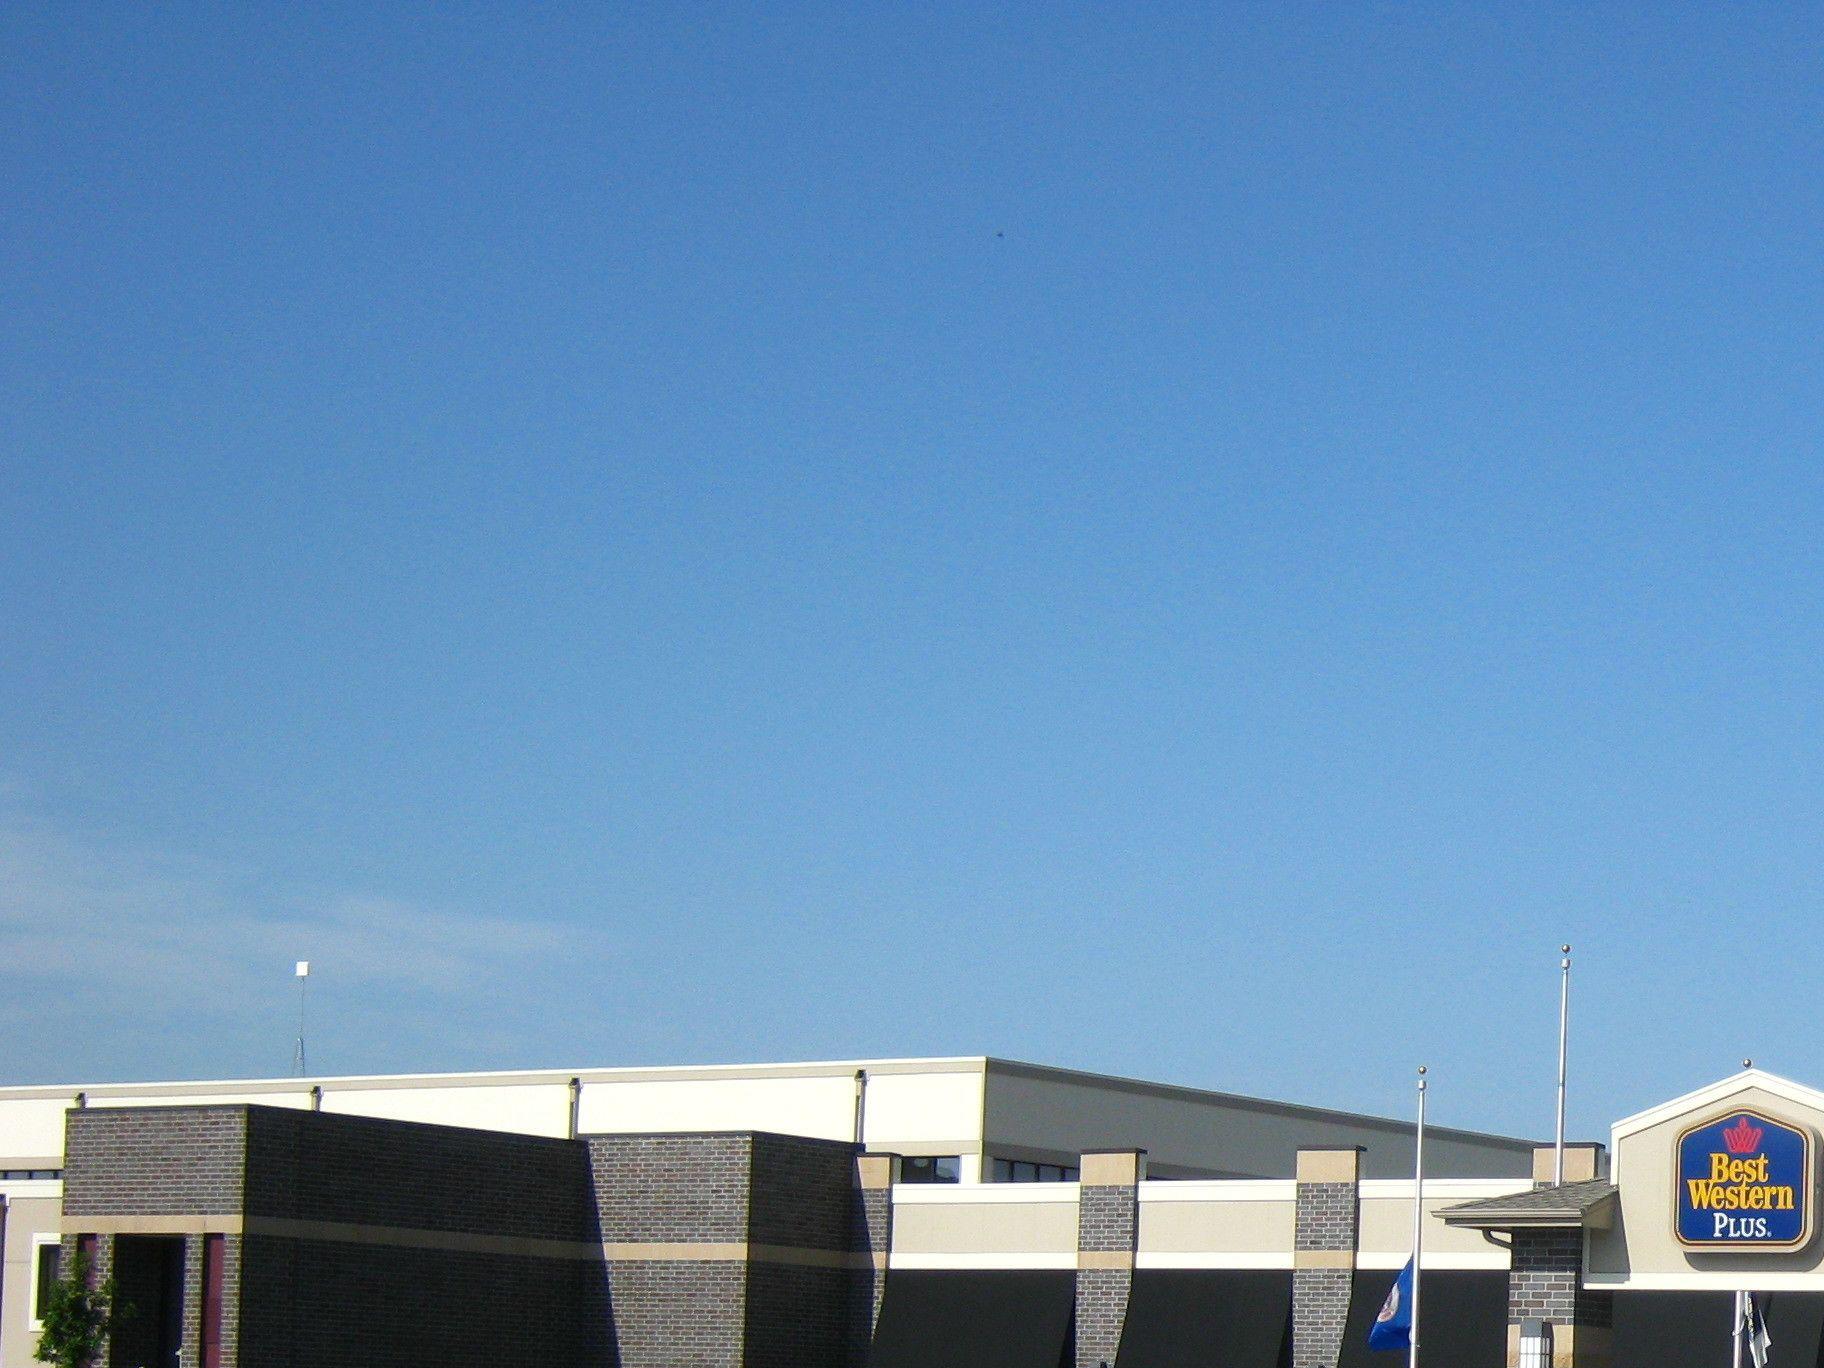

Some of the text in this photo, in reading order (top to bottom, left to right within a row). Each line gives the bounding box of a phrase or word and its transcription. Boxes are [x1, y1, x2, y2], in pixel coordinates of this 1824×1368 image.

[1710, 1152, 1769, 1183] Best
[1687, 1179, 1795, 1210] Western
[1713, 1212, 1767, 1238] PLUS
